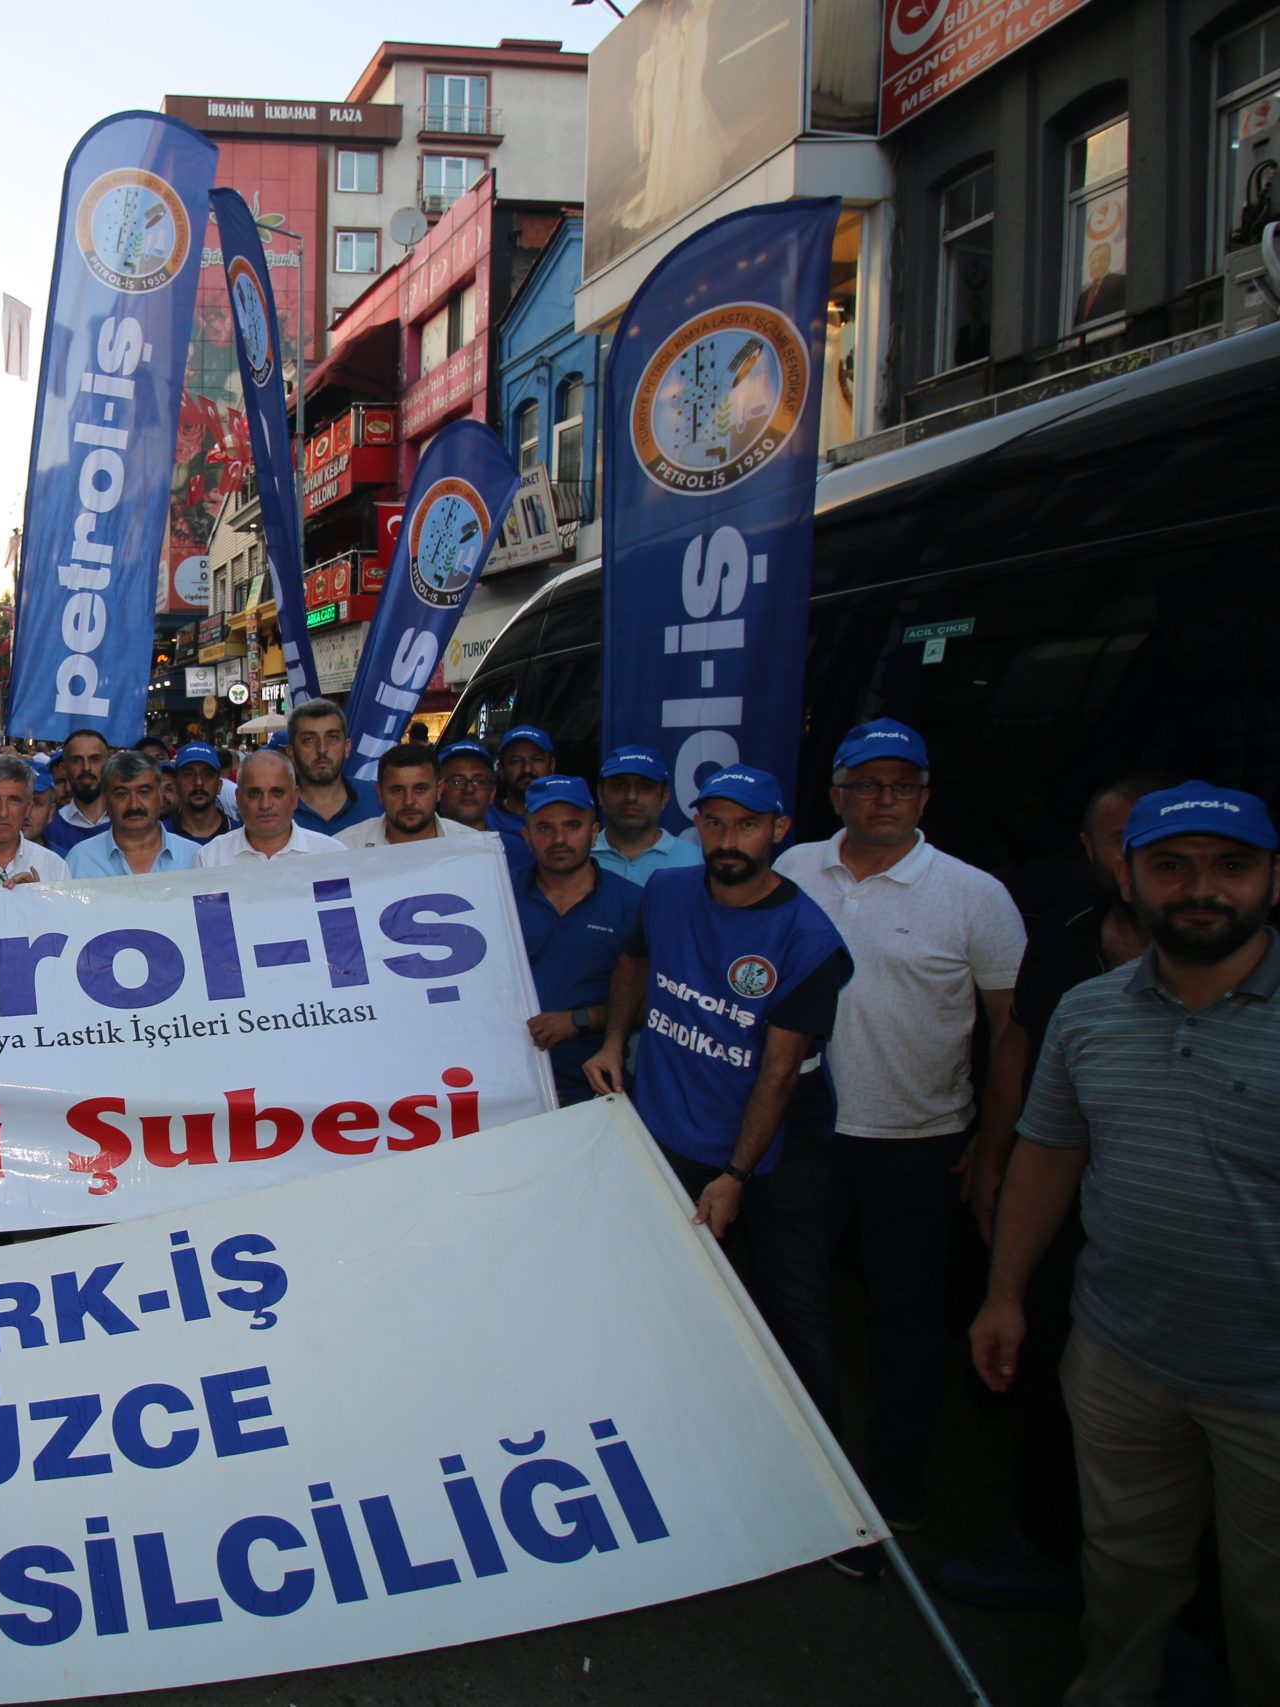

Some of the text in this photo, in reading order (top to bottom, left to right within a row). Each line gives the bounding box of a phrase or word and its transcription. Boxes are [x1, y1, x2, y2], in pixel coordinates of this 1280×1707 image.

[943, 0, 997, 35] BÜY
[893, 0, 1031, 96] ZONGULDA
[901, 40, 997, 114] MERKEZ
[207, 99, 363, 122] İBRAHİM İLKBAHAR PLAZA
[142, 272, 166, 288] 1950
[643, 352, 673, 393] PETROL
[673, 322, 710, 351] KİMYA
[736, 438, 776, 475] 1950
[55, 316, 153, 717] petrol-iş
[309, 480, 337, 510] SALONU
[32, 1016, 125, 1050] Lastik
[130, 1010, 231, 1050] İşçileri
[237, 1001, 378, 1036] Sendikası
[656, 972, 756, 1029] petrol-iş
[647, 1008, 752, 1068] SENDİKASI
[66, 1066, 480, 1196] Şubesi
